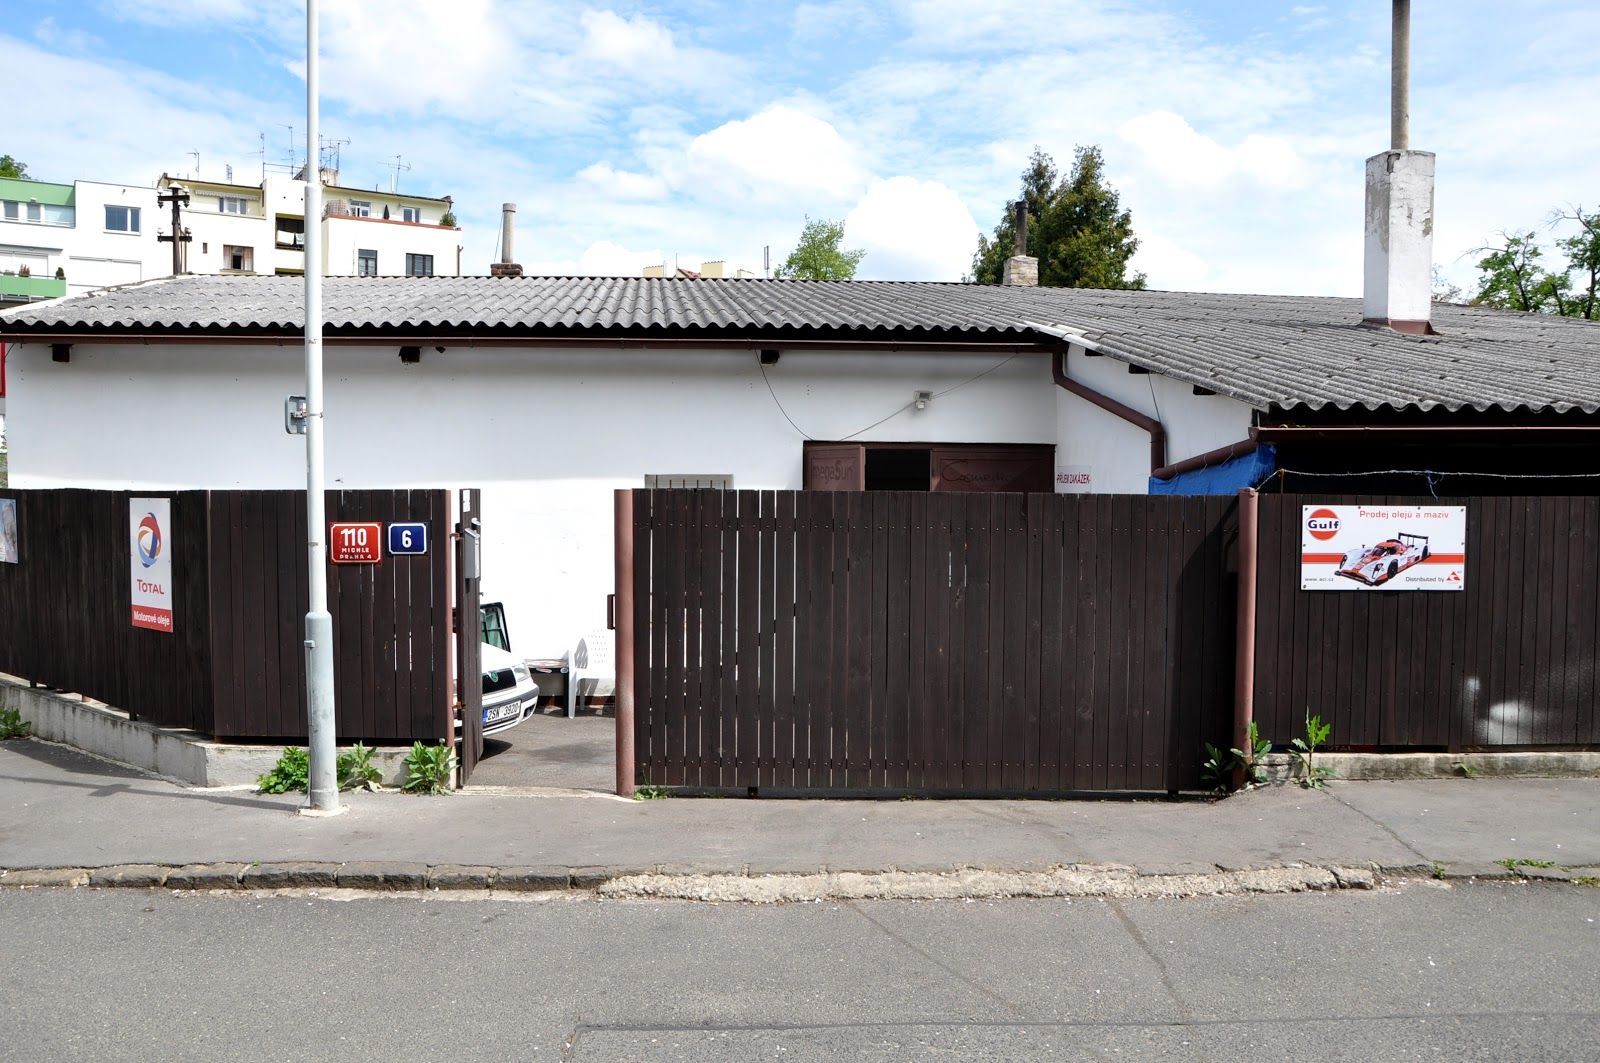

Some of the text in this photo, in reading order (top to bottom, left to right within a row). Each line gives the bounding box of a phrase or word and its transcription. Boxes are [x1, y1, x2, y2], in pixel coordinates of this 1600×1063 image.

[1359, 510, 1389, 520] Prodej
[1423, 511, 1449, 519] maziv
[1307, 519, 1340, 530] Gulf
[340, 528, 367, 547] 110
[401, 529, 412, 548] 6
[133, 610, 170, 627] Motorové oleje
